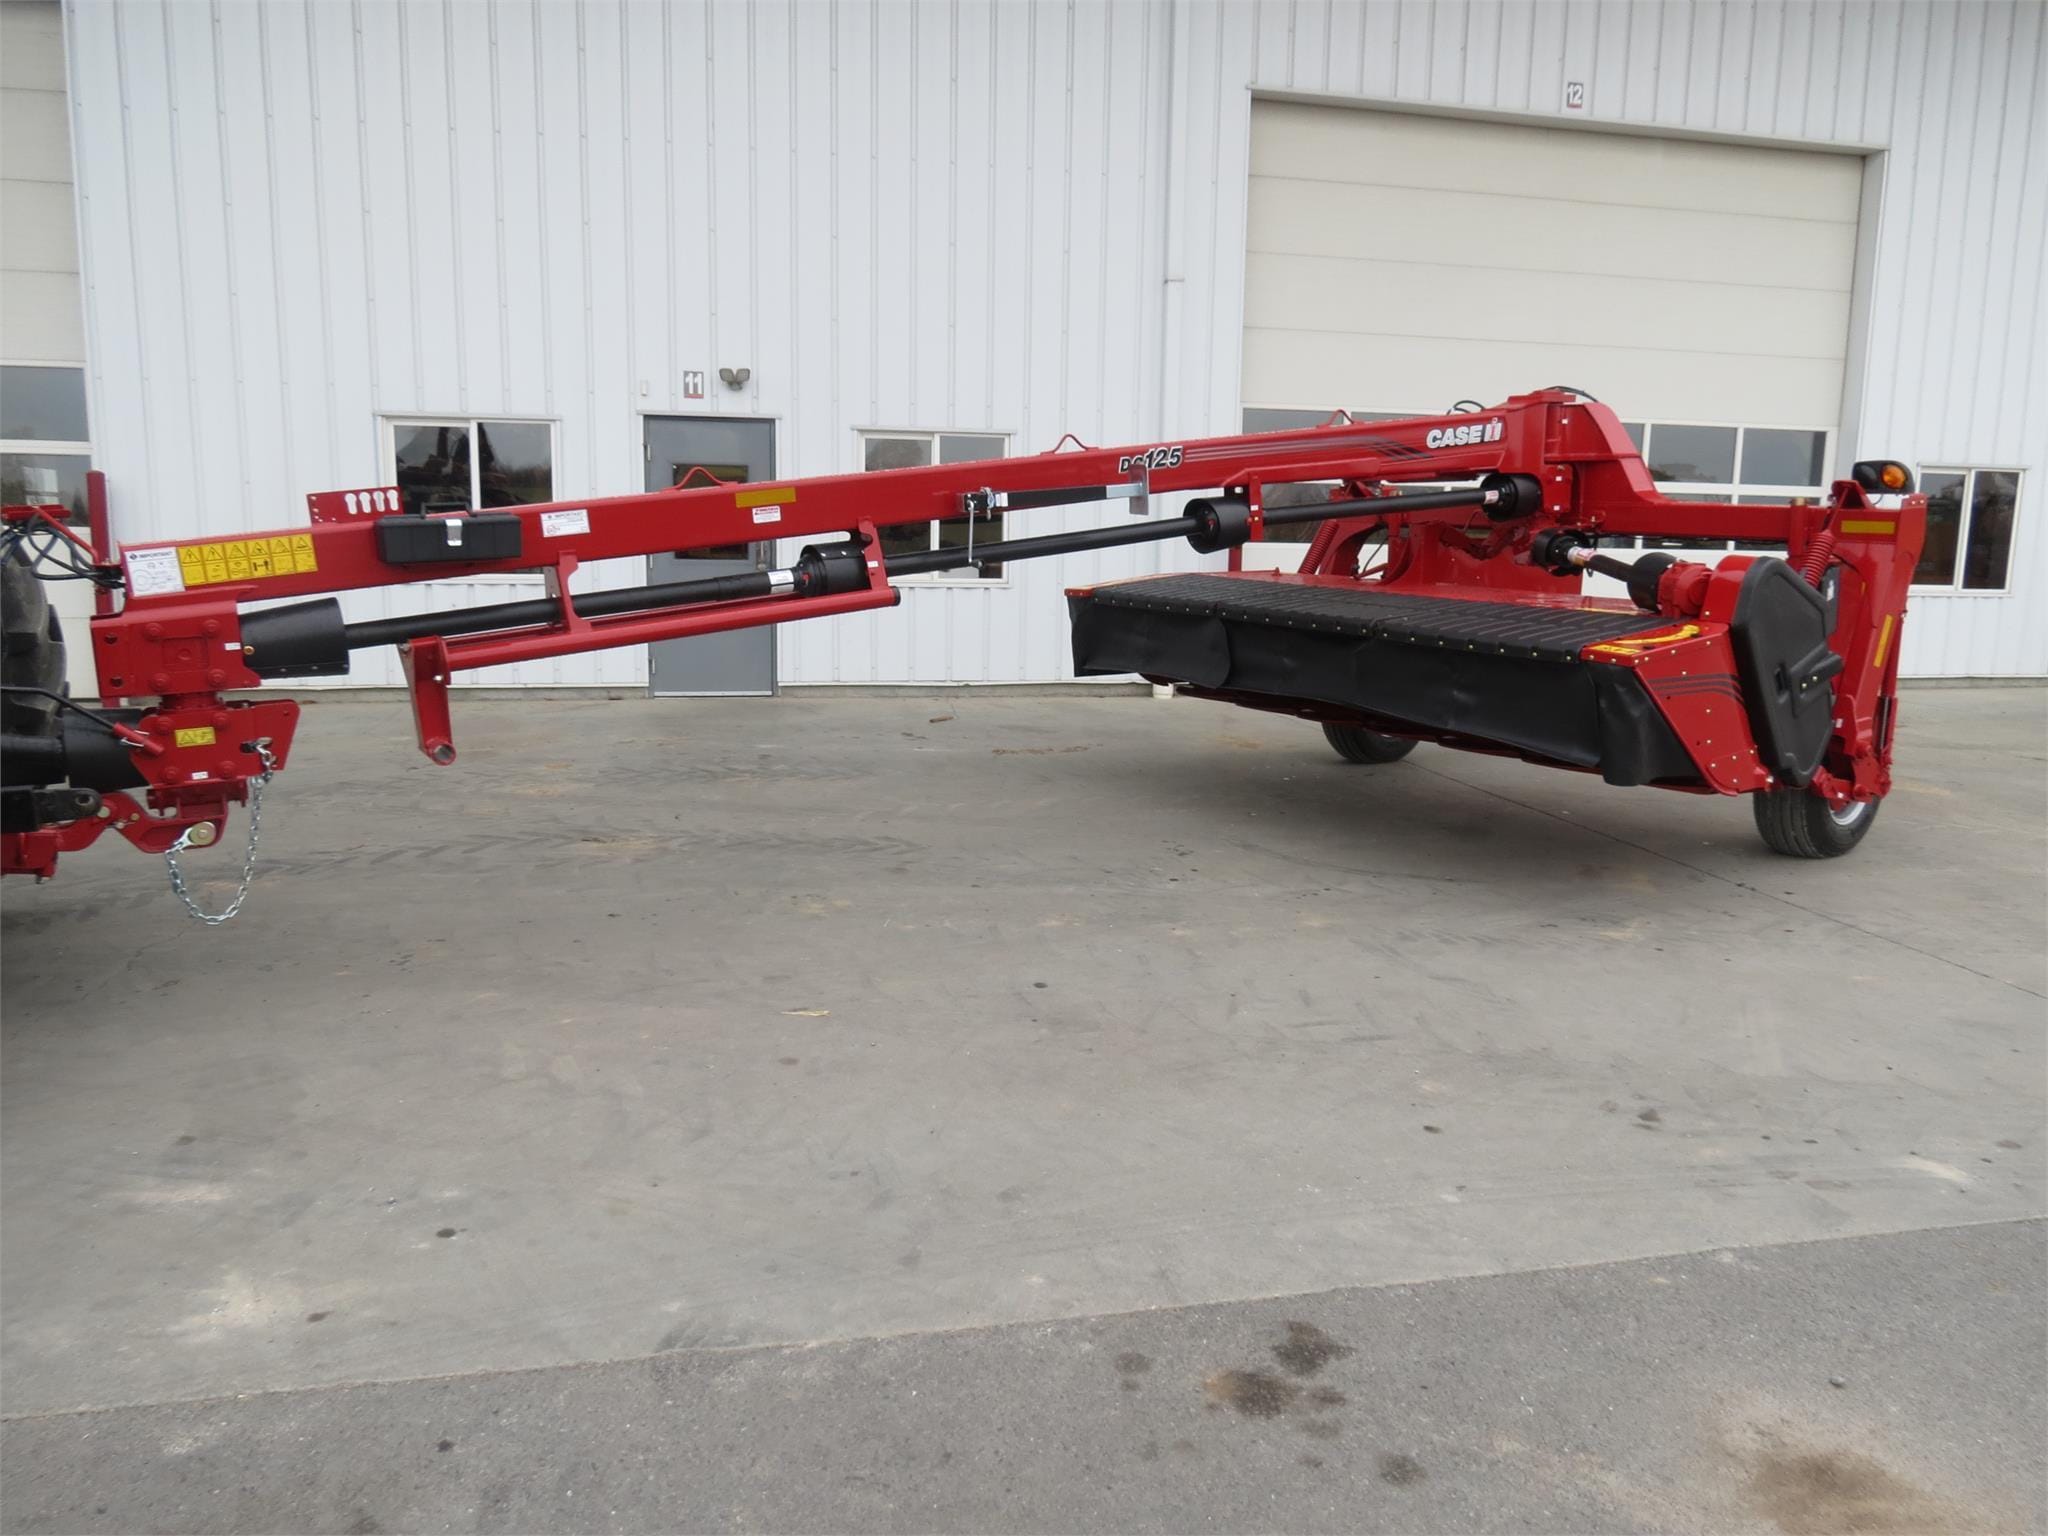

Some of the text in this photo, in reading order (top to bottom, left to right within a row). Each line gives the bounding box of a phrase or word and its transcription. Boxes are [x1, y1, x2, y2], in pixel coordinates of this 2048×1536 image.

[1567, 84, 1582, 104] 12
[685, 372, 703, 394] 11
[1426, 424, 1484, 449] CASE
